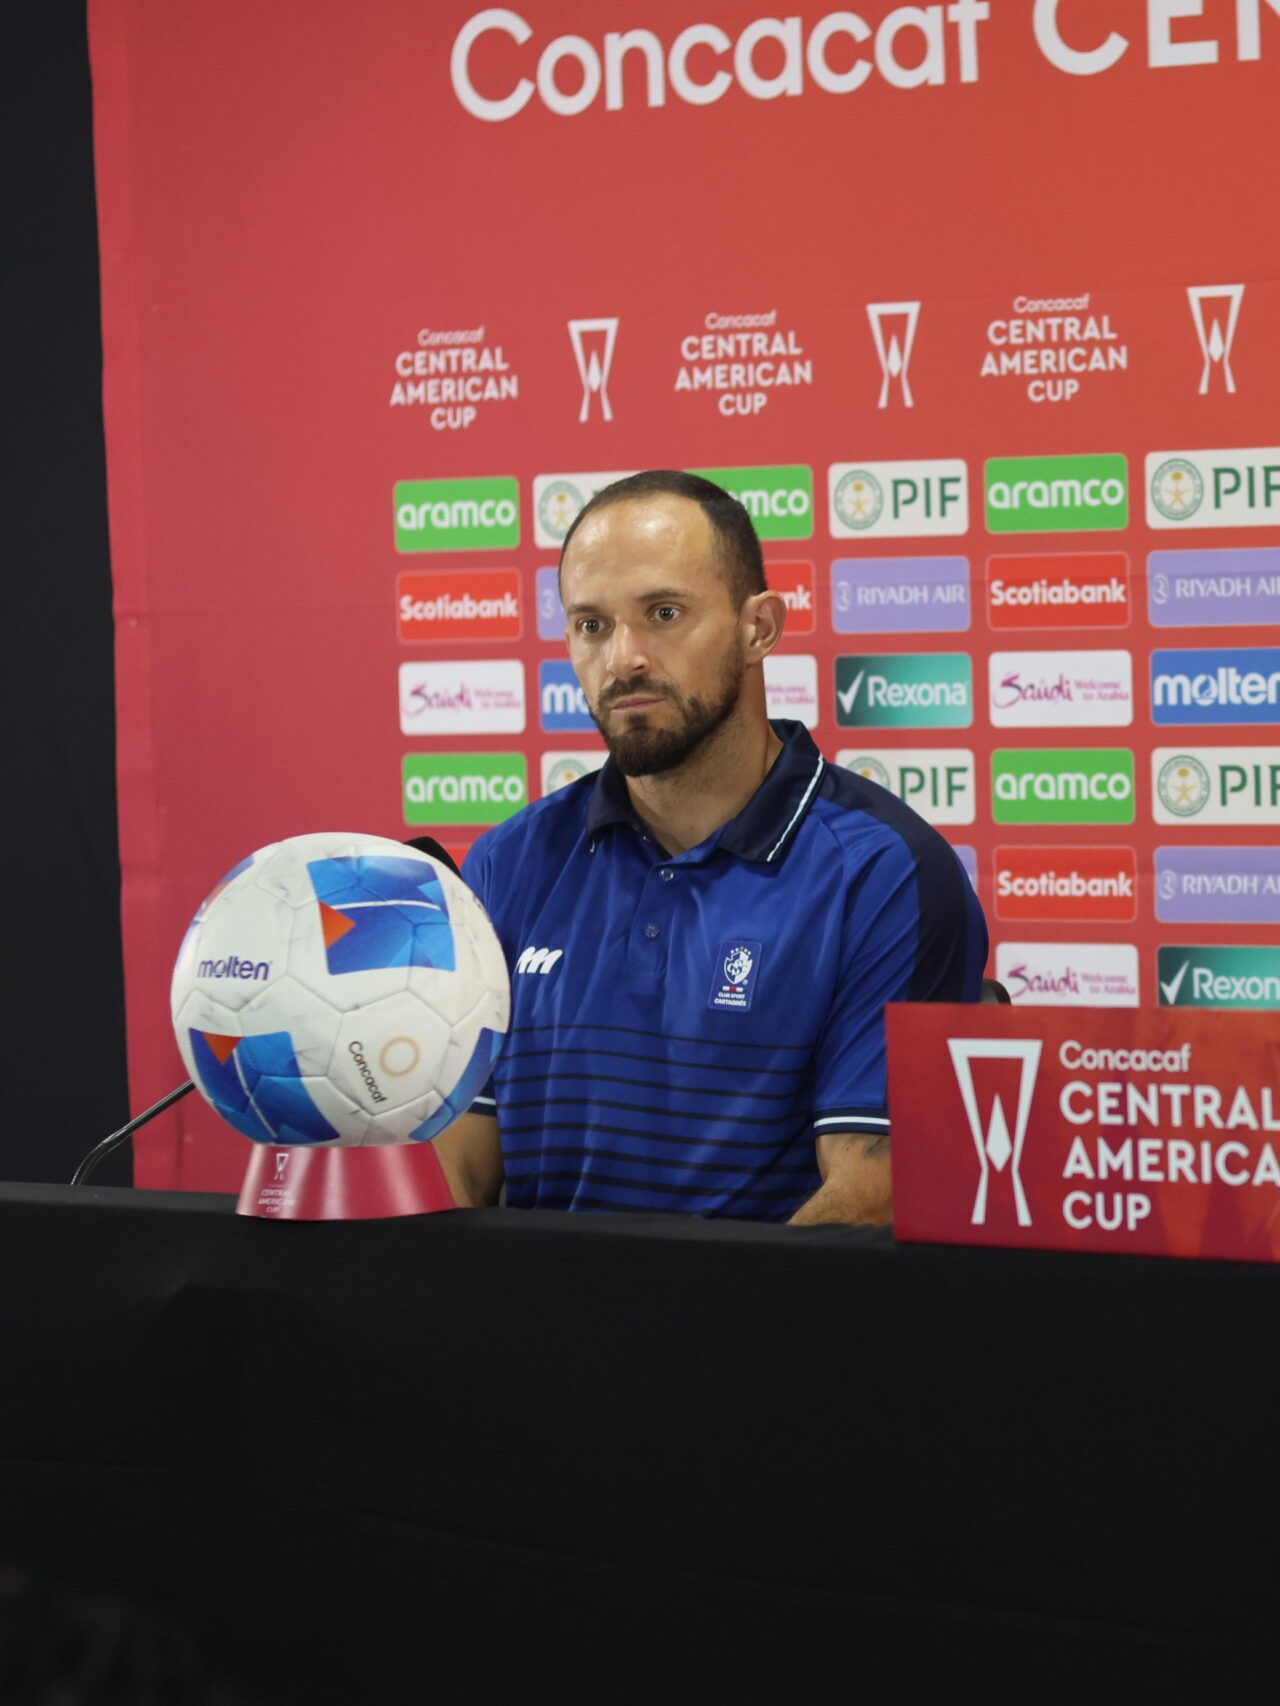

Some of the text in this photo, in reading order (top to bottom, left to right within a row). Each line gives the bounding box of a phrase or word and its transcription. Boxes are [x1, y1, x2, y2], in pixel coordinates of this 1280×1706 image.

[451, 0, 989, 121] Concacaf
[1013, 293, 1089, 313] Concacaf
[705, 310, 776, 330] Concacaf
[988, 316, 1117, 345] CENTRAL
[681, 331, 802, 360] CENTRAL
[396, 347, 508, 376] CENTRAL
[981, 346, 1127, 376] AMERICAN
[675, 361, 811, 390] AMERICAN
[390, 376, 518, 405] AMERICAN
[719, 393, 767, 416] CUP
[1028, 379, 1079, 402] CUP
[431, 406, 476, 429] CUP
[892, 477, 961, 518] PIF
[988, 479, 1124, 509] aramco
[397, 500, 516, 529] aramco
[858, 585, 965, 605] RIYADH AIR
[991, 578, 1125, 605] Scotiabank
[1176, 578, 1251, 597] RIYADH
[400, 593, 518, 620] Scotiabank
[869, 677, 966, 705] Rexona
[991, 667, 1122, 709] Saudi Welcome
[1081, 688, 1130, 702] to Arabia
[405, 775, 525, 802] aramco
[897, 764, 968, 808] PIF
[995, 773, 1131, 800] aramco
[997, 871, 1132, 896] Scotiabank
[1182, 875, 1258, 894] RIYADH
[198, 956, 269, 981] molten
[1007, 966, 1131, 1001] Saudi Welcome
[1105, 981, 1137, 996] Arabia
[1059, 1040, 1190, 1072] Concacaf
[349, 1041, 387, 1103] Concacaf
[1063, 1191, 1151, 1230] CUP
